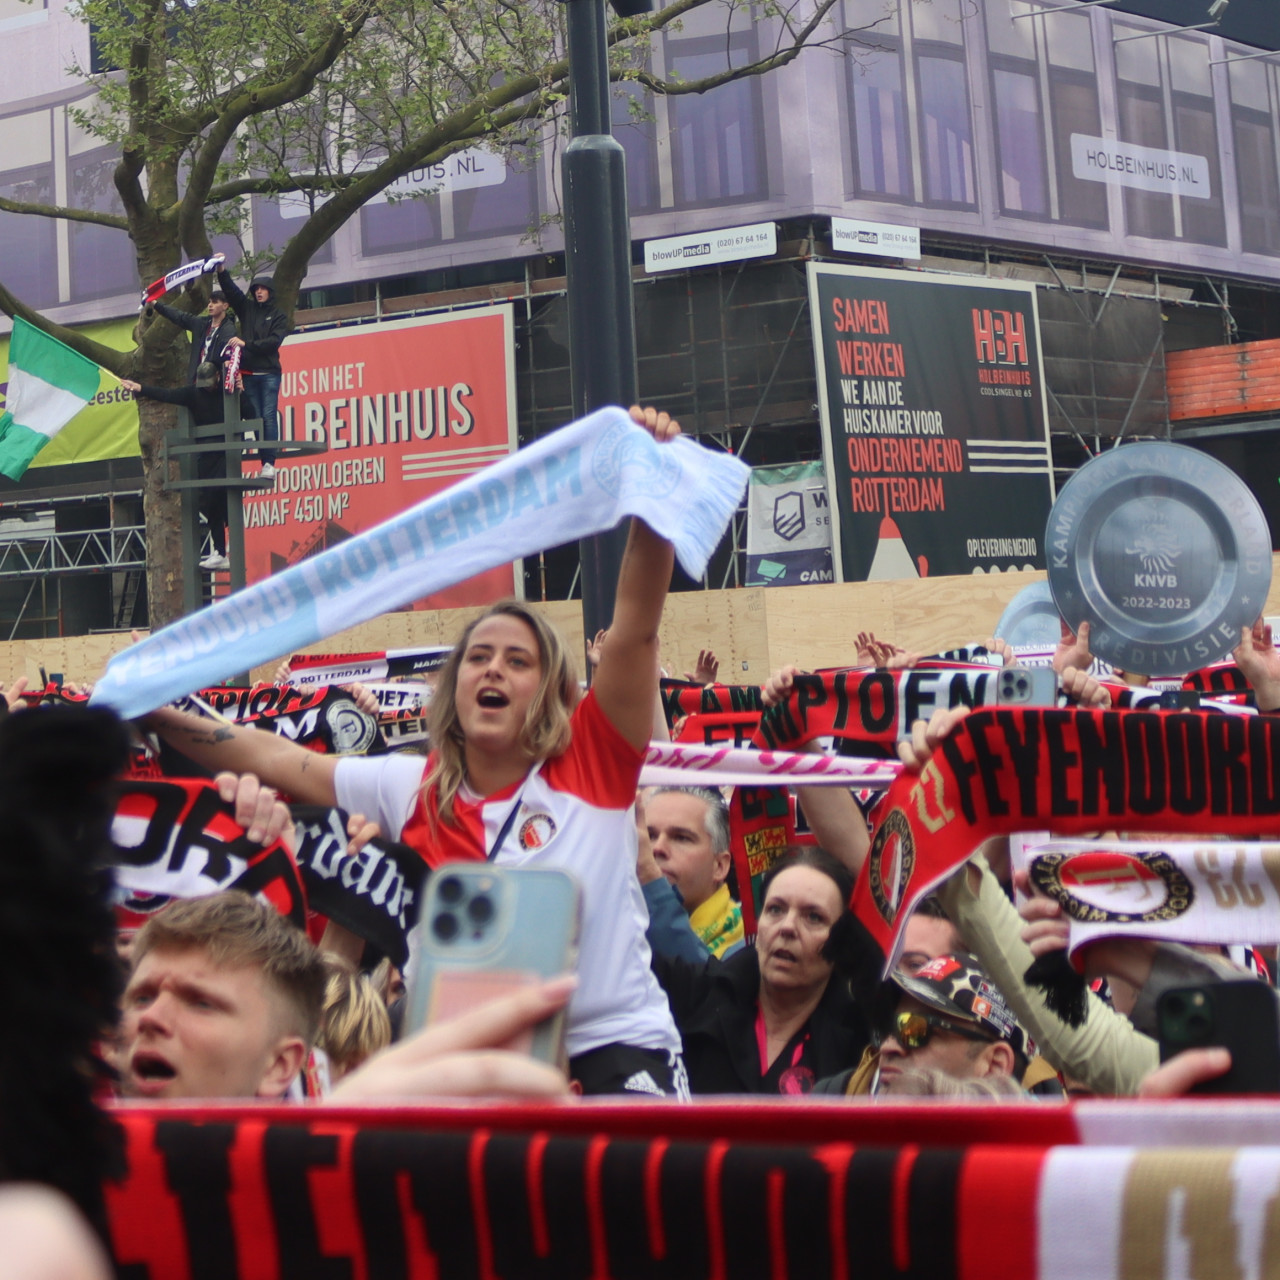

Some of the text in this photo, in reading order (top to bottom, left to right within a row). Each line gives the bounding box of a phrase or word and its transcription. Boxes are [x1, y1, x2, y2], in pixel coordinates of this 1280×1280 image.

[1086, 148, 1200, 186] HOLBEINHUIS.NL
[717, 237, 734, 249] (020)
[735, 236, 744, 246] 67
[745, 235, 754, 245] 64
[755, 232, 768, 243] 164
[833, 297, 890, 335] SAMEN
[837, 340, 906, 378] WERKEN
[312, 367, 329, 394] IN
[333, 362, 365, 391] HET
[841, 378, 905, 406] WE AAN DE
[978, 368, 1032, 386] HOLBEINHUIS
[1023, 388, 1033, 399] 65
[242, 383, 473, 455] LBEINHUIS
[843, 408, 945, 436] HUISKAMER VOOR
[847, 437, 964, 473] ONDERNEMEND
[851, 477, 946, 513] ROTTERDAM
[243, 498, 290, 529] VANAF
[294, 495, 324, 523] 450
[318, 445, 585, 599] ROTTERDAM
[966, 538, 1038, 558] OPLEVERING MEDIO
[1134, 573, 1178, 590] KNVB
[1122, 596, 1192, 610] 2022-2023
[1094, 620, 1236, 667] REDIVISIE
[300, 668, 372, 685] ROTTERDAM
[910, 759, 956, 835] 22
